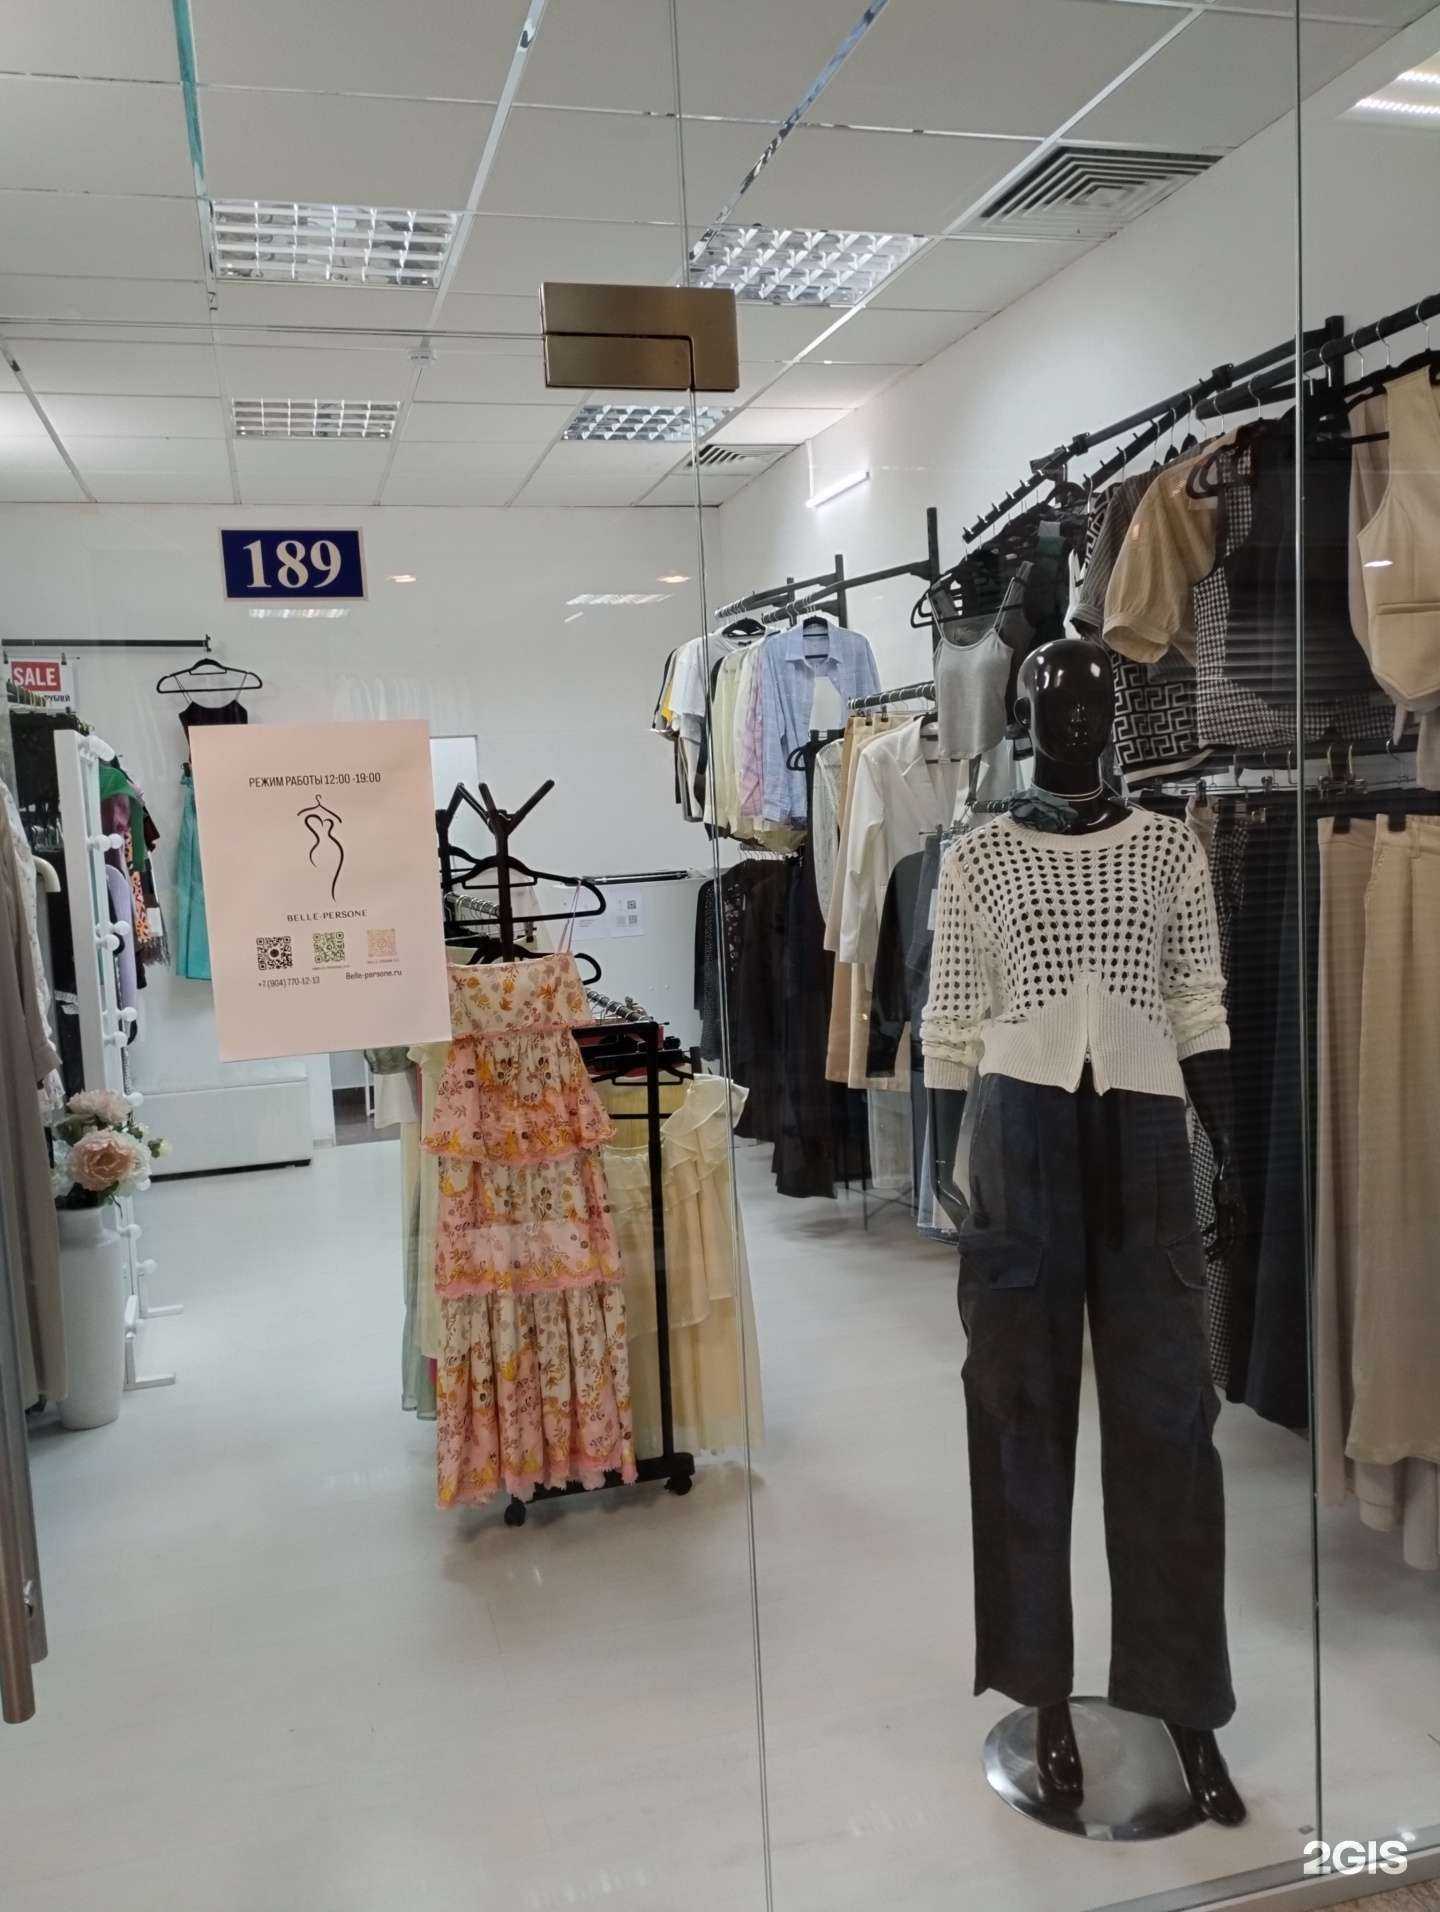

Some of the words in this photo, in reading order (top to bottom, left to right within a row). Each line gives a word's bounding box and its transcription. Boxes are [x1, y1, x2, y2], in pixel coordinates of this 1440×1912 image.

[243, 540, 341, 589] 189
[13, 667, 57, 686] SALE
[249, 777, 284, 787] РЕЖИМ
[285, 775, 323, 786] РАБОТЫ
[324, 774, 350, 785] 12:00
